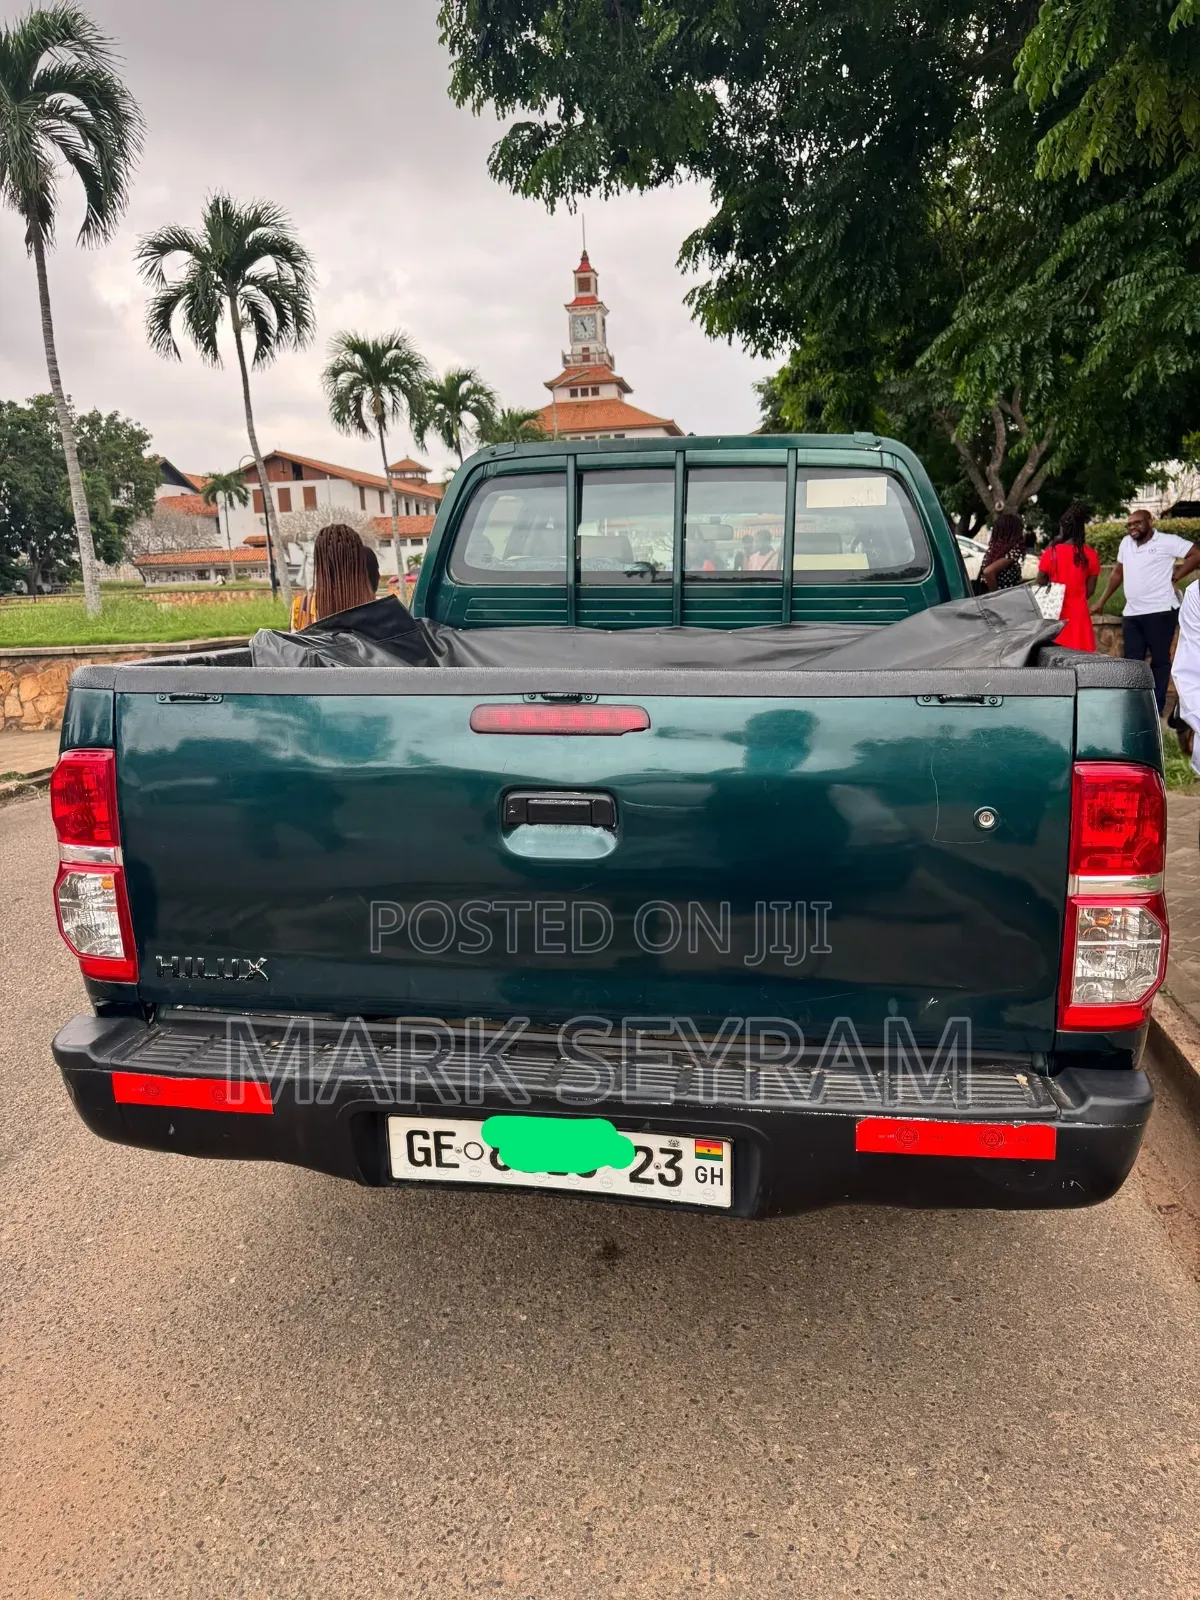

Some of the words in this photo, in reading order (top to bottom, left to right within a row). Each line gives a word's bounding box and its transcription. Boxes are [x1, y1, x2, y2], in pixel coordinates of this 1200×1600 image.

[155, 955, 270, 982] HILUX
[405, 1129, 460, 1170] GE
[628, 1145, 684, 1188] 23
[694, 1164, 725, 1187] GH
